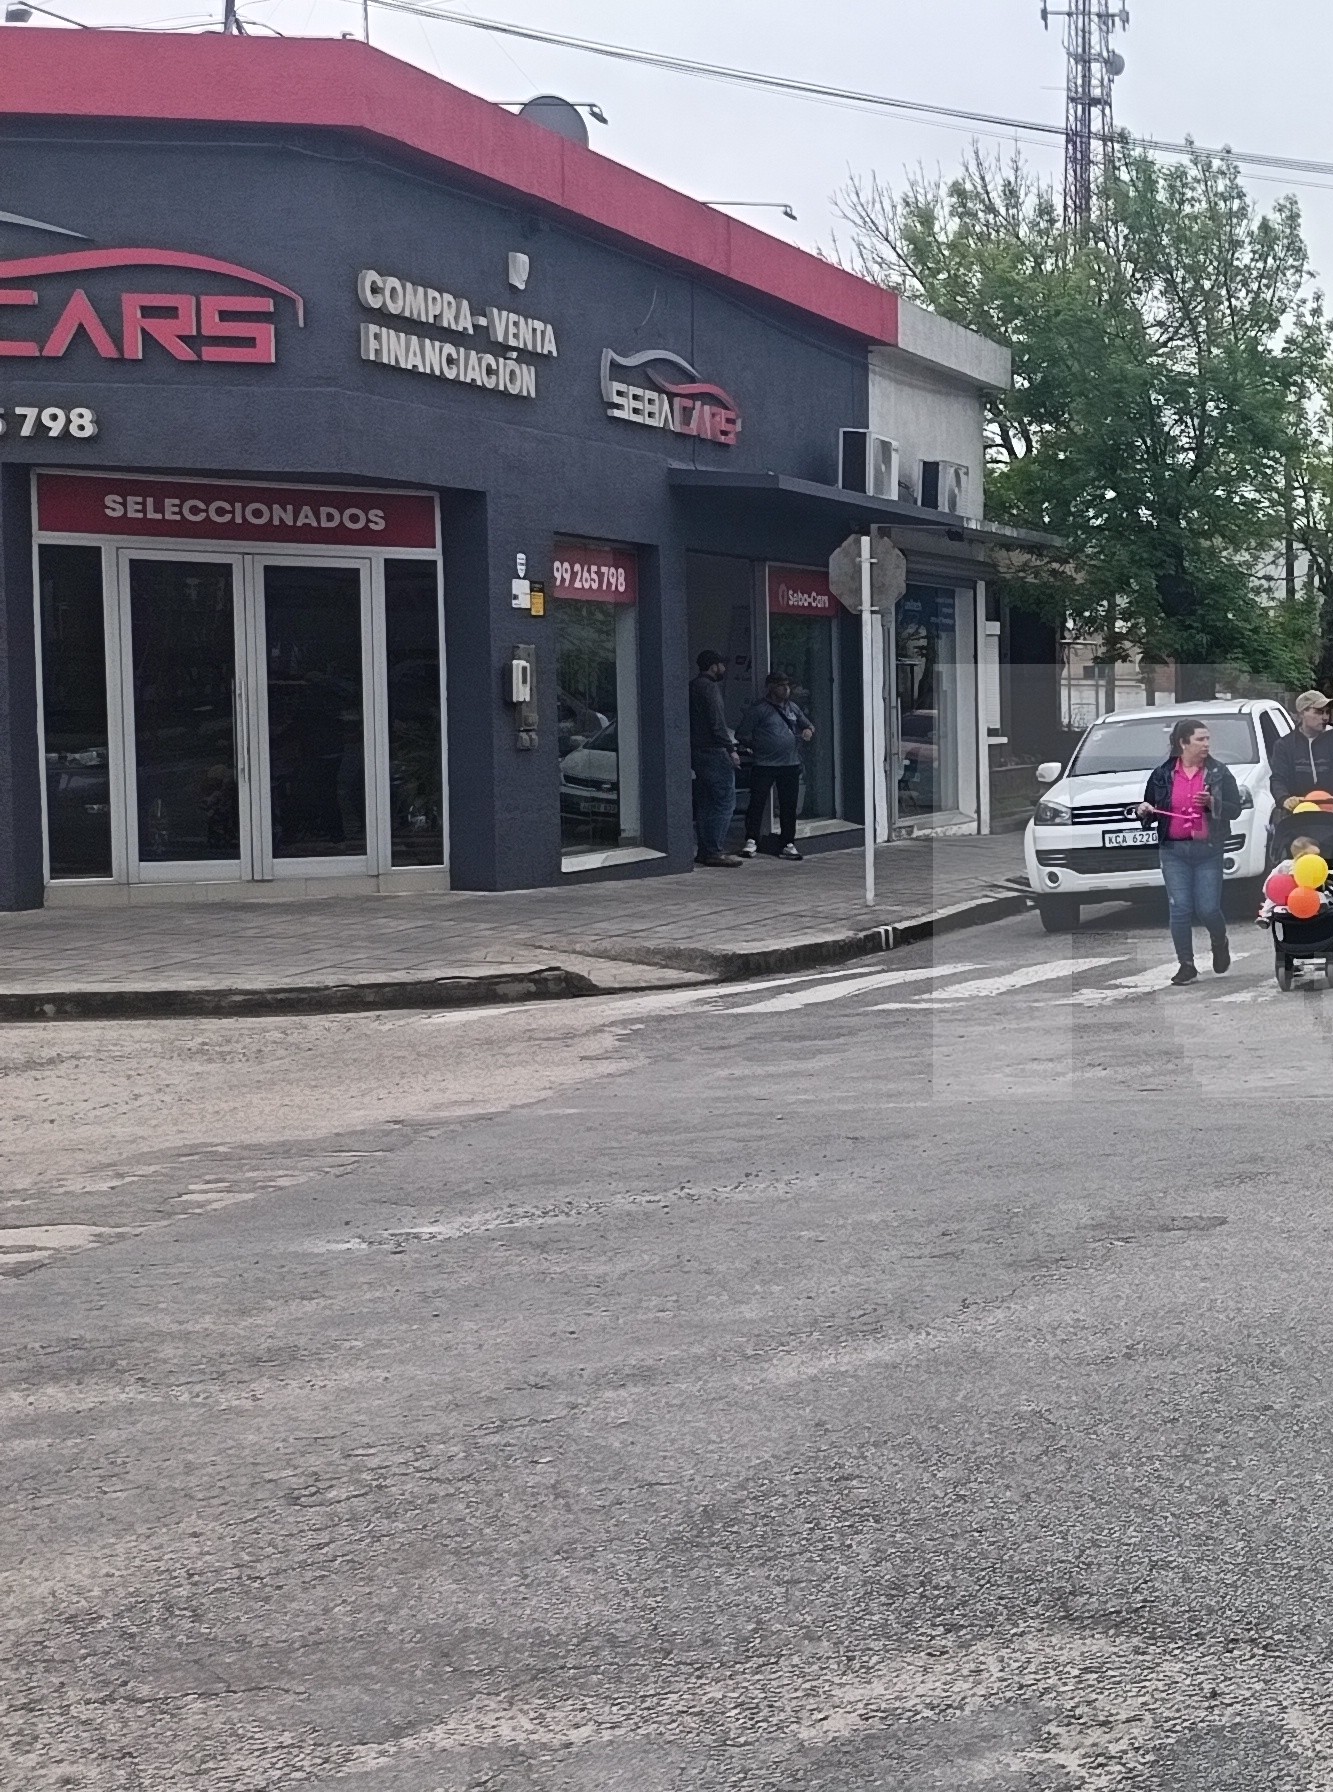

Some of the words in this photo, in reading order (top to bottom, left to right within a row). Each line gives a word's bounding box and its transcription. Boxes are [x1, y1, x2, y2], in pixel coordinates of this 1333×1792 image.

[360, 322, 536, 398] FINANCIACIÓN
[14, 406, 97, 438] 798
[104, 494, 386, 531] SELECCIONADOS
[553, 560, 571, 587] 99
[573, 563, 599, 590] 265
[600, 566, 626, 592] 798
[1108, 834, 1128, 845] KCA
